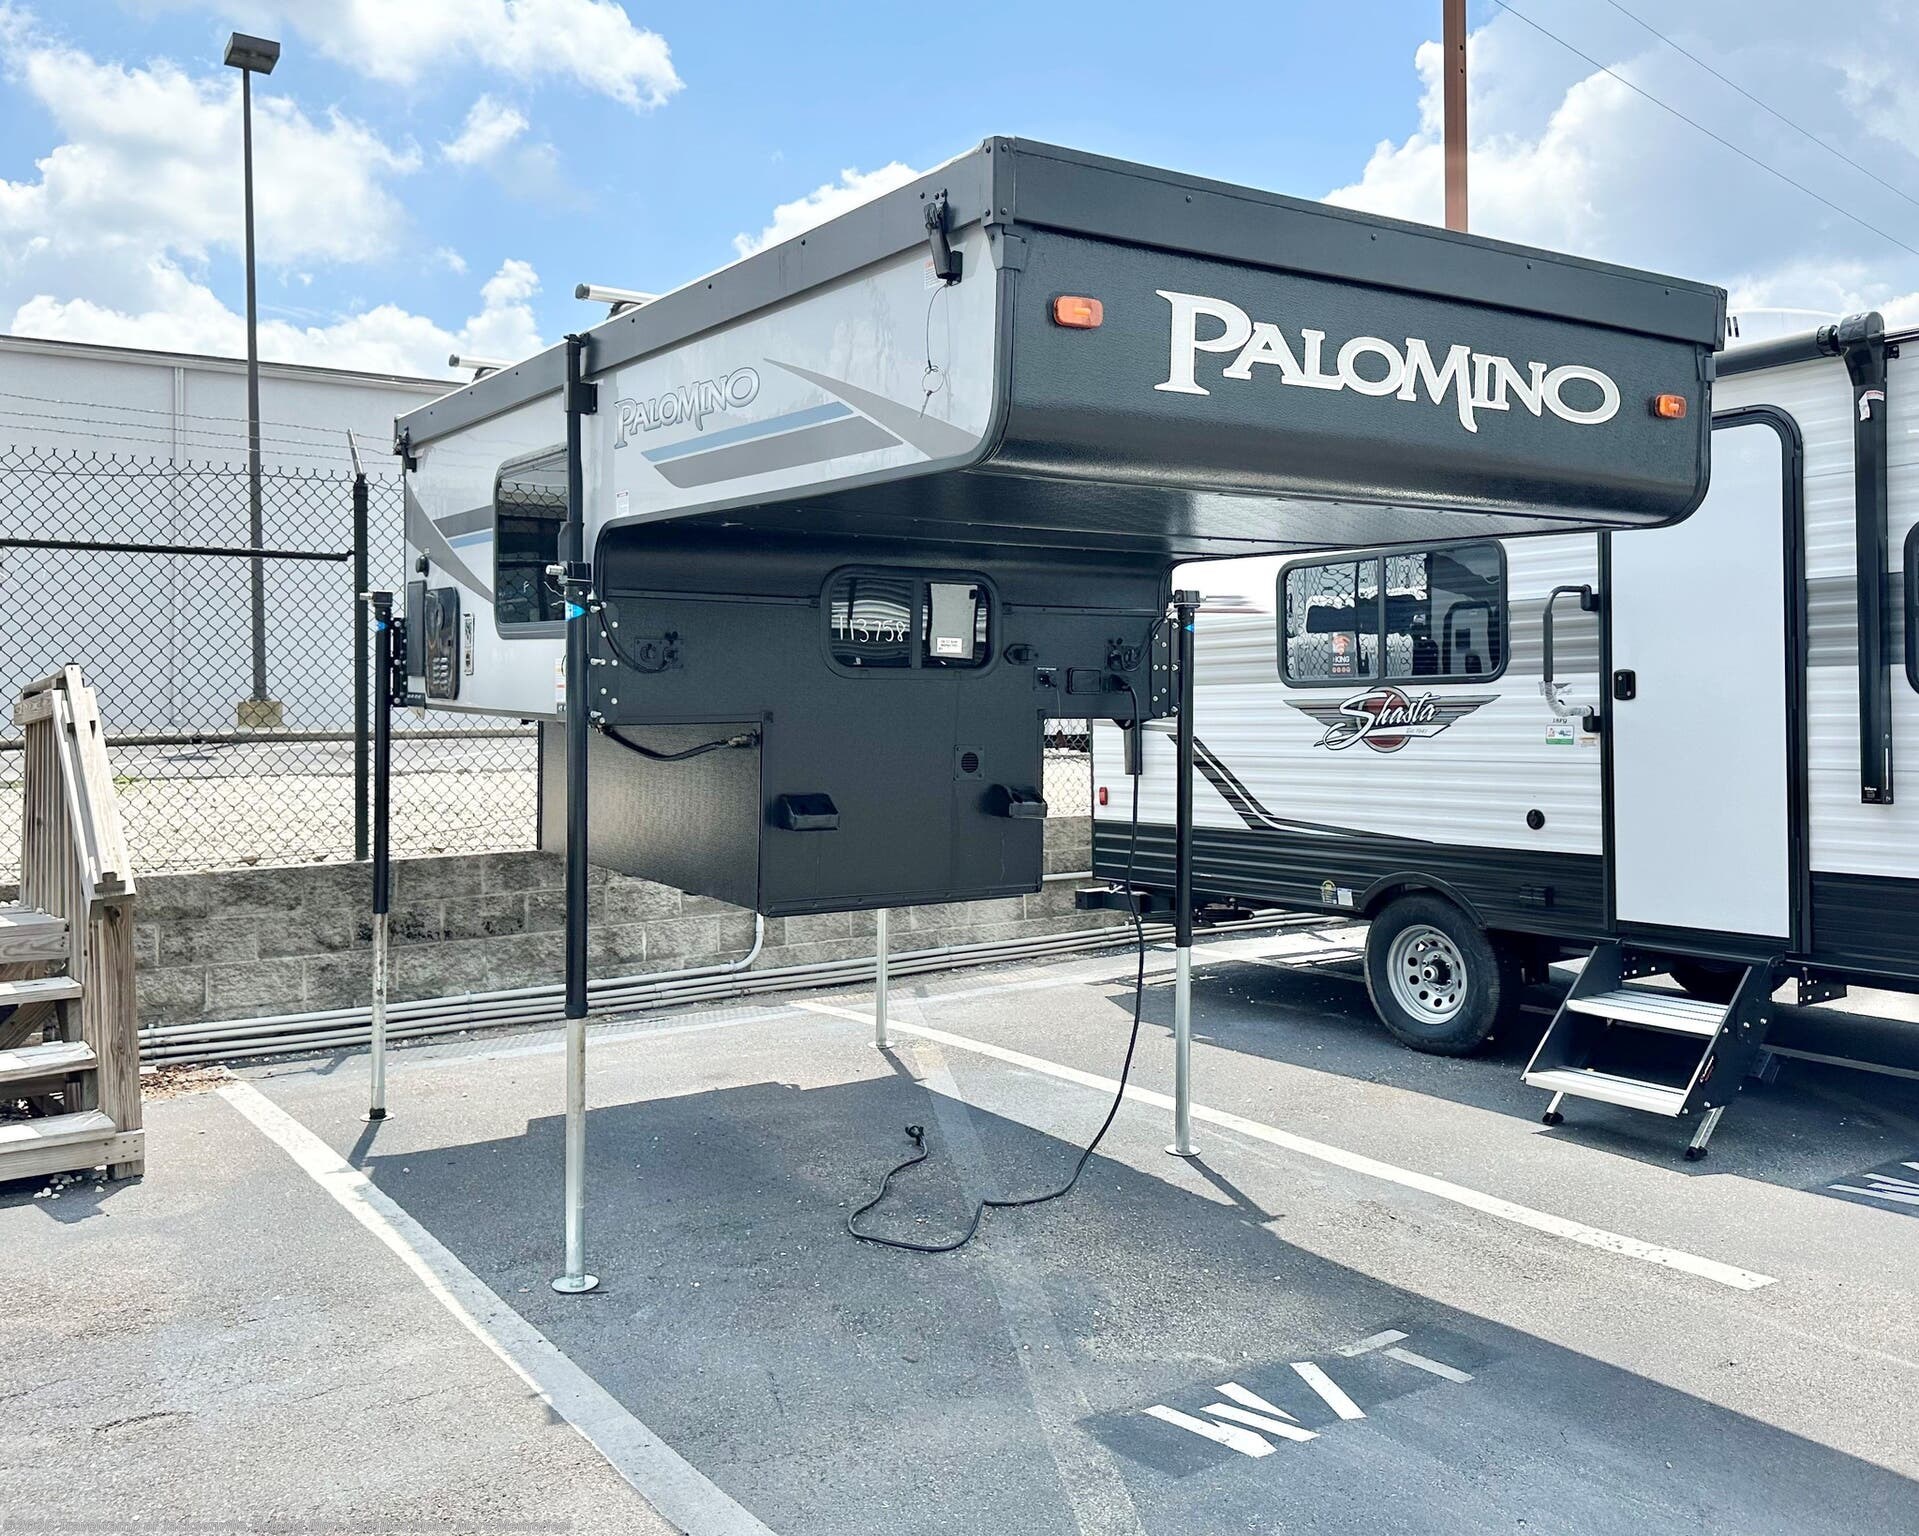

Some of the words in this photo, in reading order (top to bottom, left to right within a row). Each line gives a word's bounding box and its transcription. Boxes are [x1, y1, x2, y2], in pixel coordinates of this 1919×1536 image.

[1155, 289, 1621, 433] PALOMINO
[615, 367, 761, 449] PALOMINO
[840, 616, 907, 642] 113758
[1324, 691, 1440, 750] Shasta
